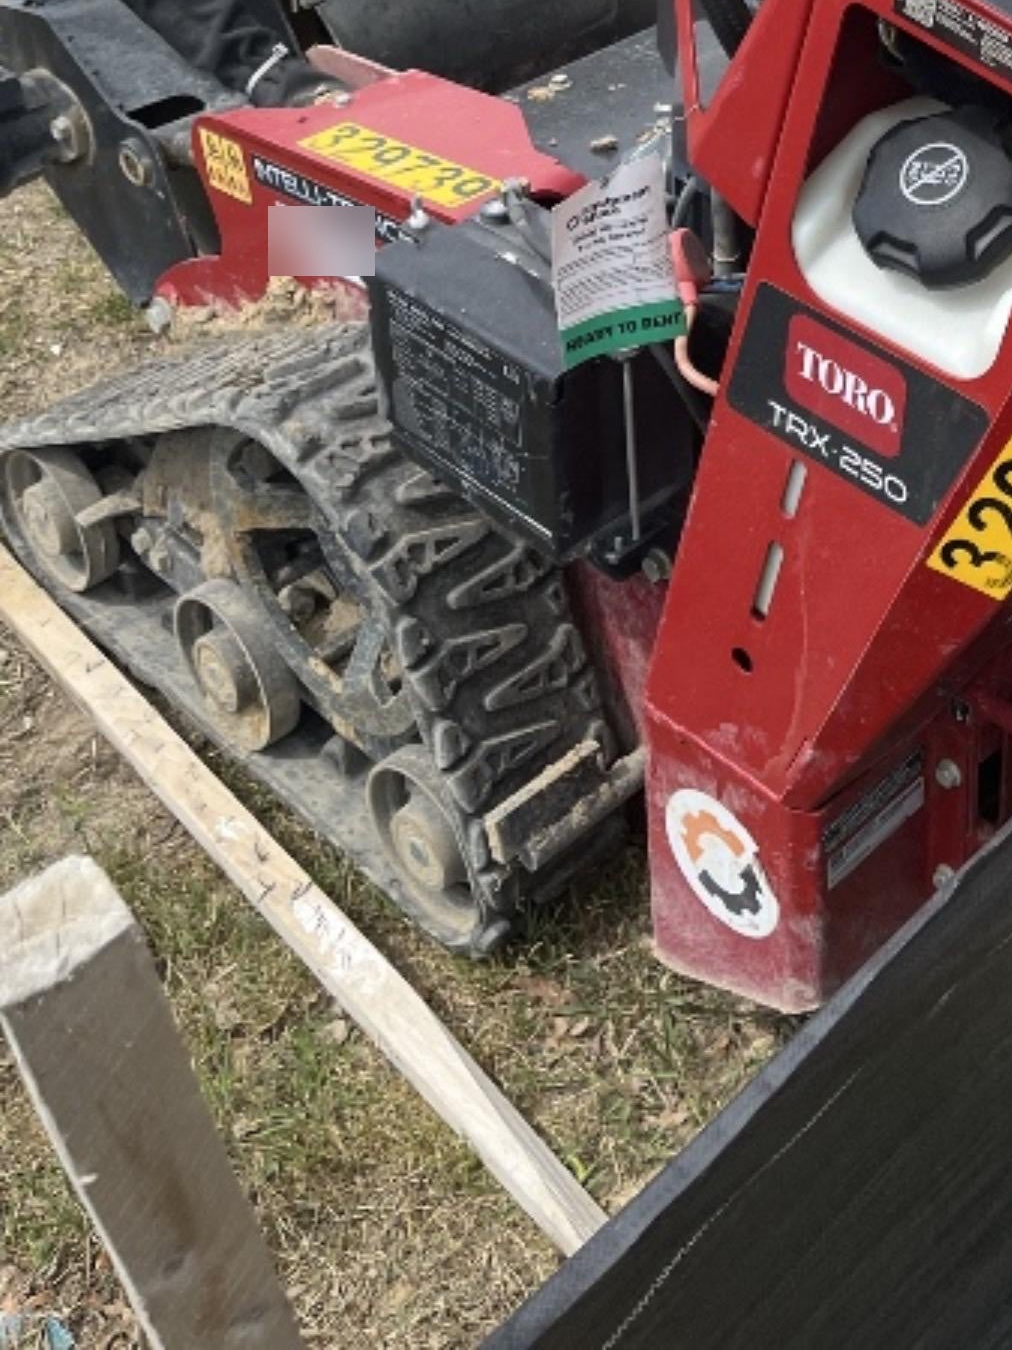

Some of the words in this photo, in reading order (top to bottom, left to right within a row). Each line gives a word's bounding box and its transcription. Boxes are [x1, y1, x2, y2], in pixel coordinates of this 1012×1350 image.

[619, 320, 636, 334] TO
[796, 341, 896, 424] TORO
[768, 399, 908, 503] TRX-250
